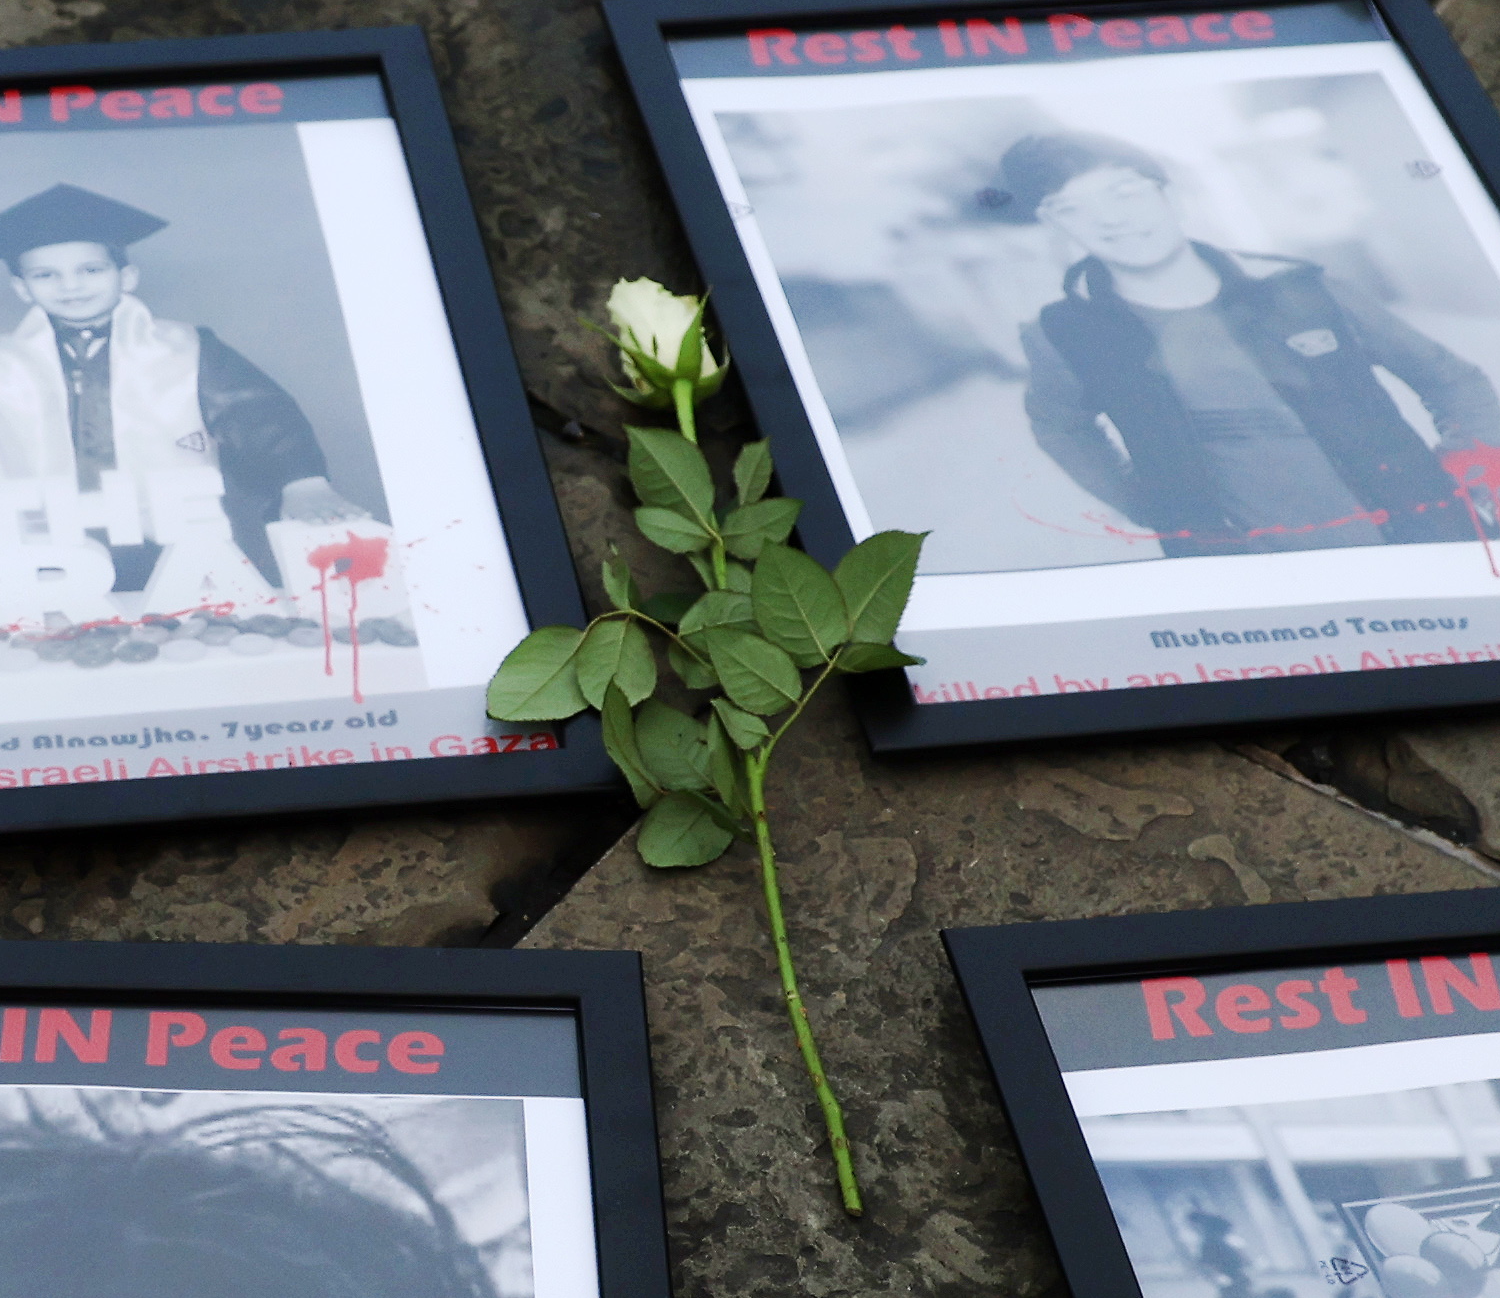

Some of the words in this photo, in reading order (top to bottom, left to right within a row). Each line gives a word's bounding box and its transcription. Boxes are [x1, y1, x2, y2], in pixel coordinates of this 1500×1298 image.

[746, 24, 918, 64] Rest
[937, 16, 1026, 55] IN
[1045, 11, 1275, 49] Peace
[49, 84, 282, 120] Peace
[1149, 620, 1340, 649] Muhammad
[913, 675, 1041, 704] killed
[1127, 672, 1183, 689] an
[1195, 655, 1341, 684] Israeli
[345, 710, 398, 729] old
[148, 747, 353, 777] Airstrike
[373, 747, 412, 761] in
[430, 733, 558, 757] Gaza
[1141, 967, 1366, 1039] Rest
[0, 1008, 112, 1062] IN
[146, 1012, 444, 1073] Peace
